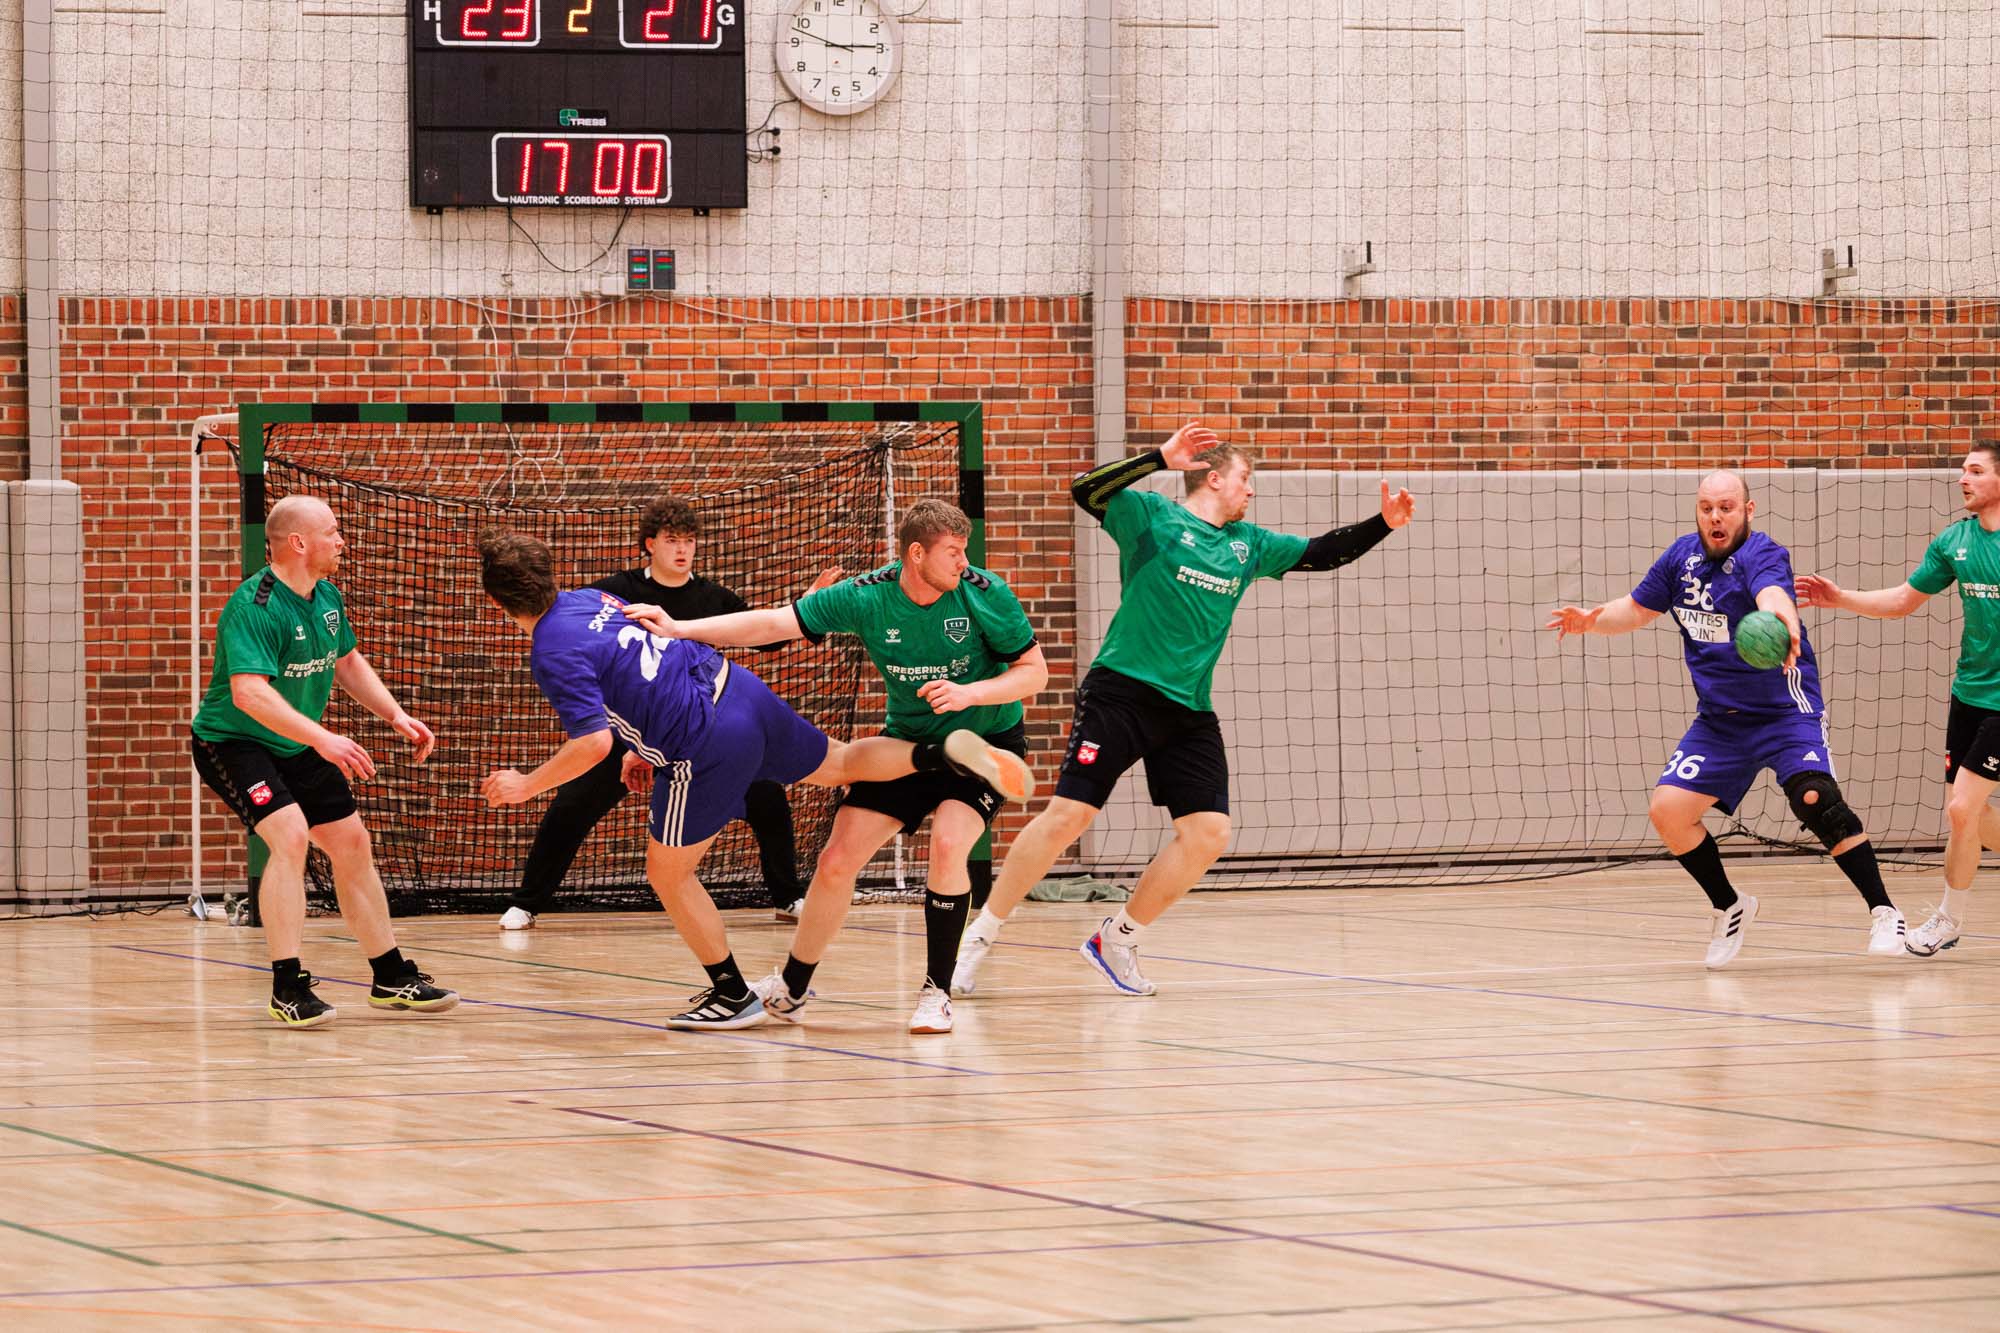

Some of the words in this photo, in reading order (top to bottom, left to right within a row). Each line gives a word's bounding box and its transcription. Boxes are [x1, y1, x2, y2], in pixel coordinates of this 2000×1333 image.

[424, 0, 441, 21] H
[716, 4, 736, 26] G
[461, 0, 530, 38] 23
[567, 0, 592, 33] 2
[643, 0, 713, 39] 21
[797, 18, 811, 29] 10
[869, 23, 879, 34] 2
[791, 37, 800, 48] 9
[876, 43, 885, 54] 3
[796, 61, 806, 73] 8
[867, 66, 878, 77] 4
[812, 78, 822, 89] 7
[852, 81, 862, 92] 5
[831, 86, 841, 97] 6
[570, 117, 607, 127] TRESS
[509, 195, 560, 205] NAUTRONIC
[564, 196, 620, 205] SCOREBOARD
[624, 196, 657, 206] SYSTEM
[1683, 577, 1714, 611] 36
[886, 665, 949, 676] FREDERIKS
[1662, 750, 1706, 781] 36
